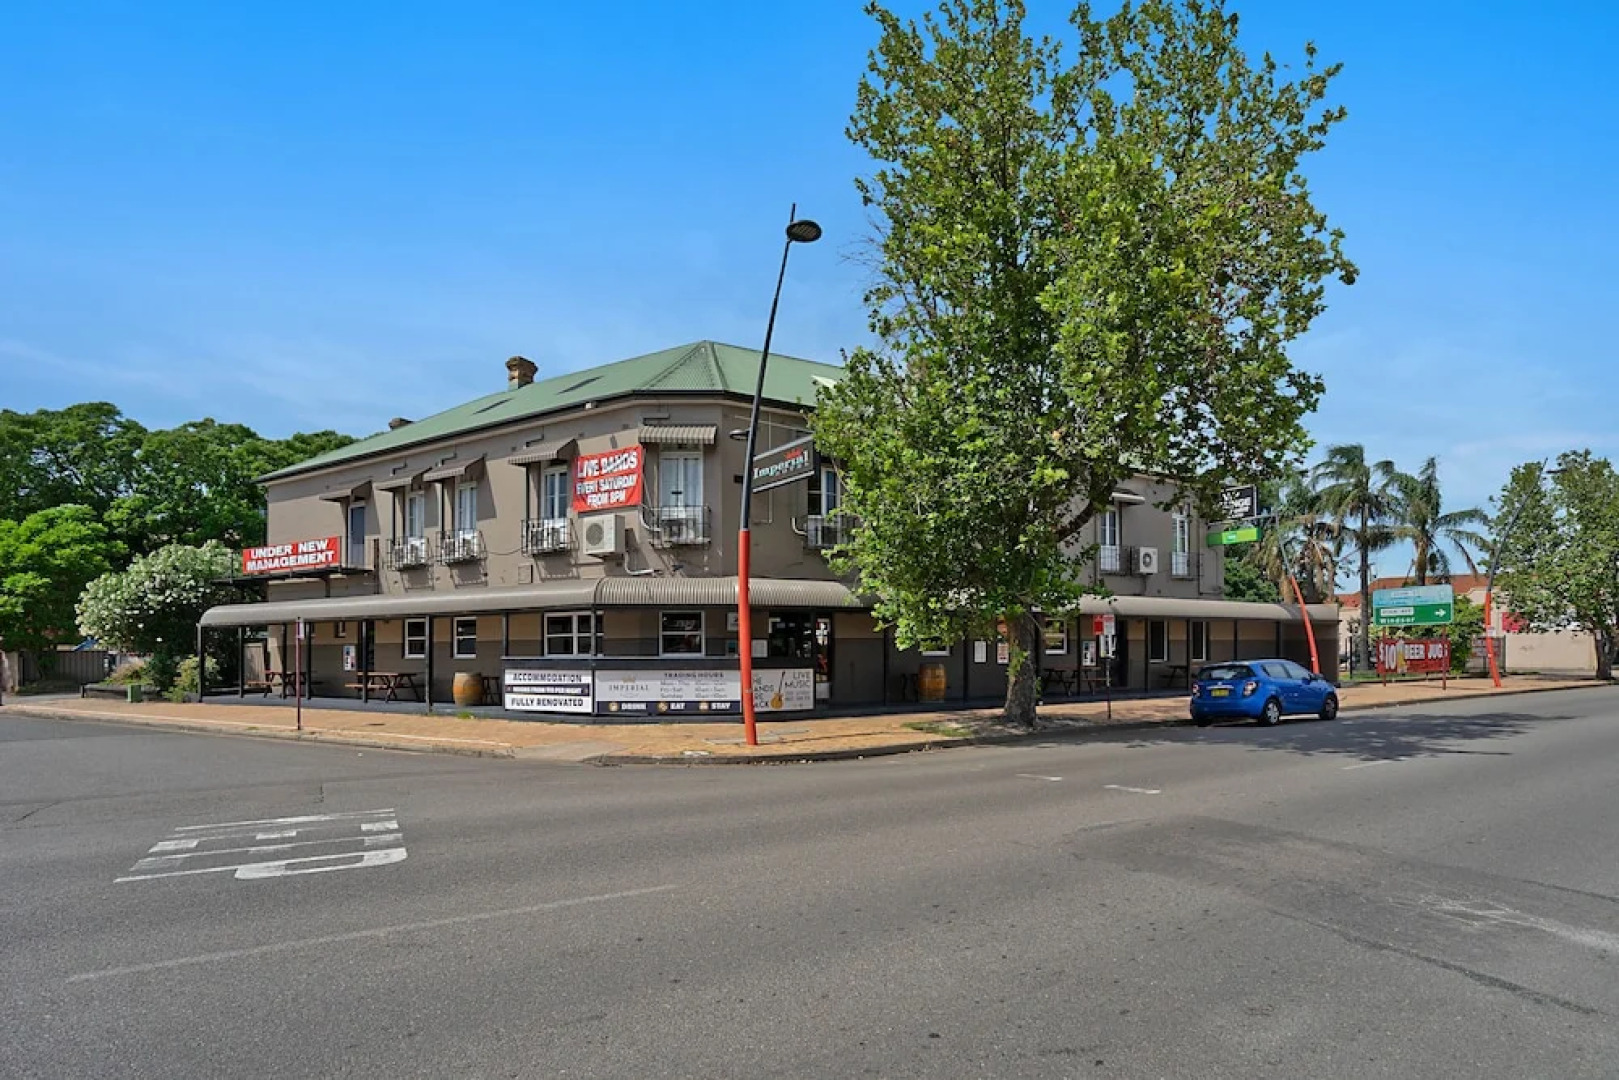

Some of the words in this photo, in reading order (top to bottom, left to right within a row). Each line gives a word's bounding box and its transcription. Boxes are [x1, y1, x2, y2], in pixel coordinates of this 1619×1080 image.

[577, 459, 600, 479] LIVE
[600, 450, 638, 475] BANDS
[753, 449, 809, 480] Imperial
[598, 472, 638, 492] SATURDAY
[587, 492, 609, 507] FROM
[250, 544, 292, 559] UNDER
[298, 539, 328, 553] NEW
[246, 550, 335, 571] MANAGEMENT
[512, 673, 582, 682] ACCOMMODATION
[793, 671, 811, 679] LIVE
[785, 680, 811, 688] MUSIC
[511, 698, 535, 707] FULLY
[536, 698, 584, 707] RENOVATED
[669, 702, 686, 710] EAT
[711, 702, 731, 710] STAY
[754, 700, 769, 708] ACK
